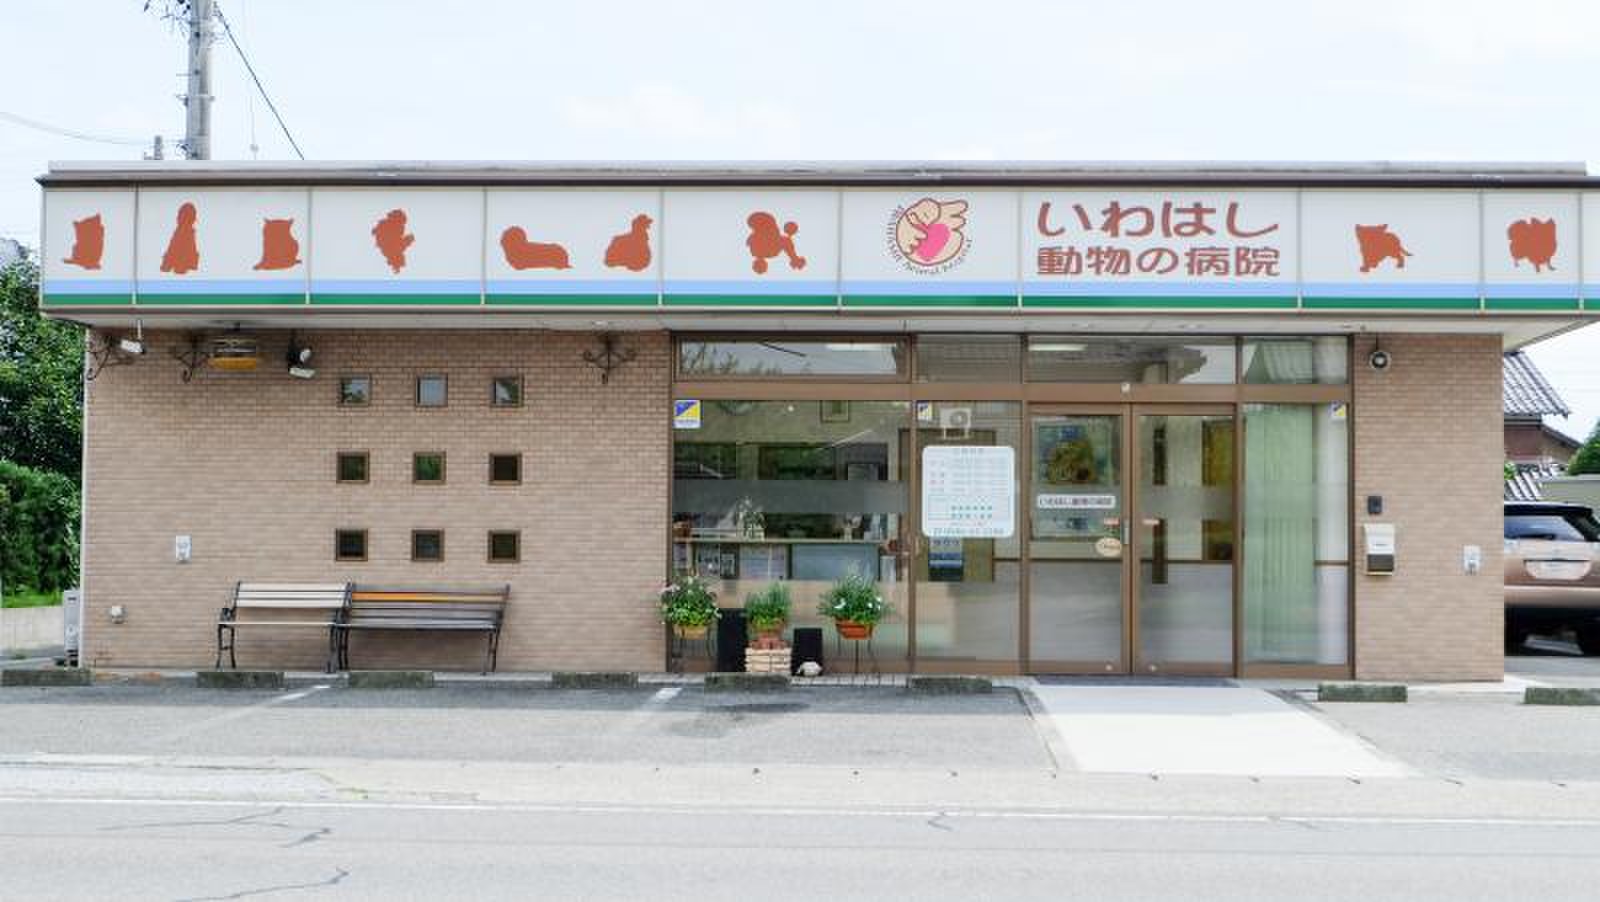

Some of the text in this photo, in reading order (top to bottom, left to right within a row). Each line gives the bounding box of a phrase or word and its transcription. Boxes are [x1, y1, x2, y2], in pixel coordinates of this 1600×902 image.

[1037, 200, 1279, 238] いわはし
[1036, 245, 1281, 277] 動物の病院
